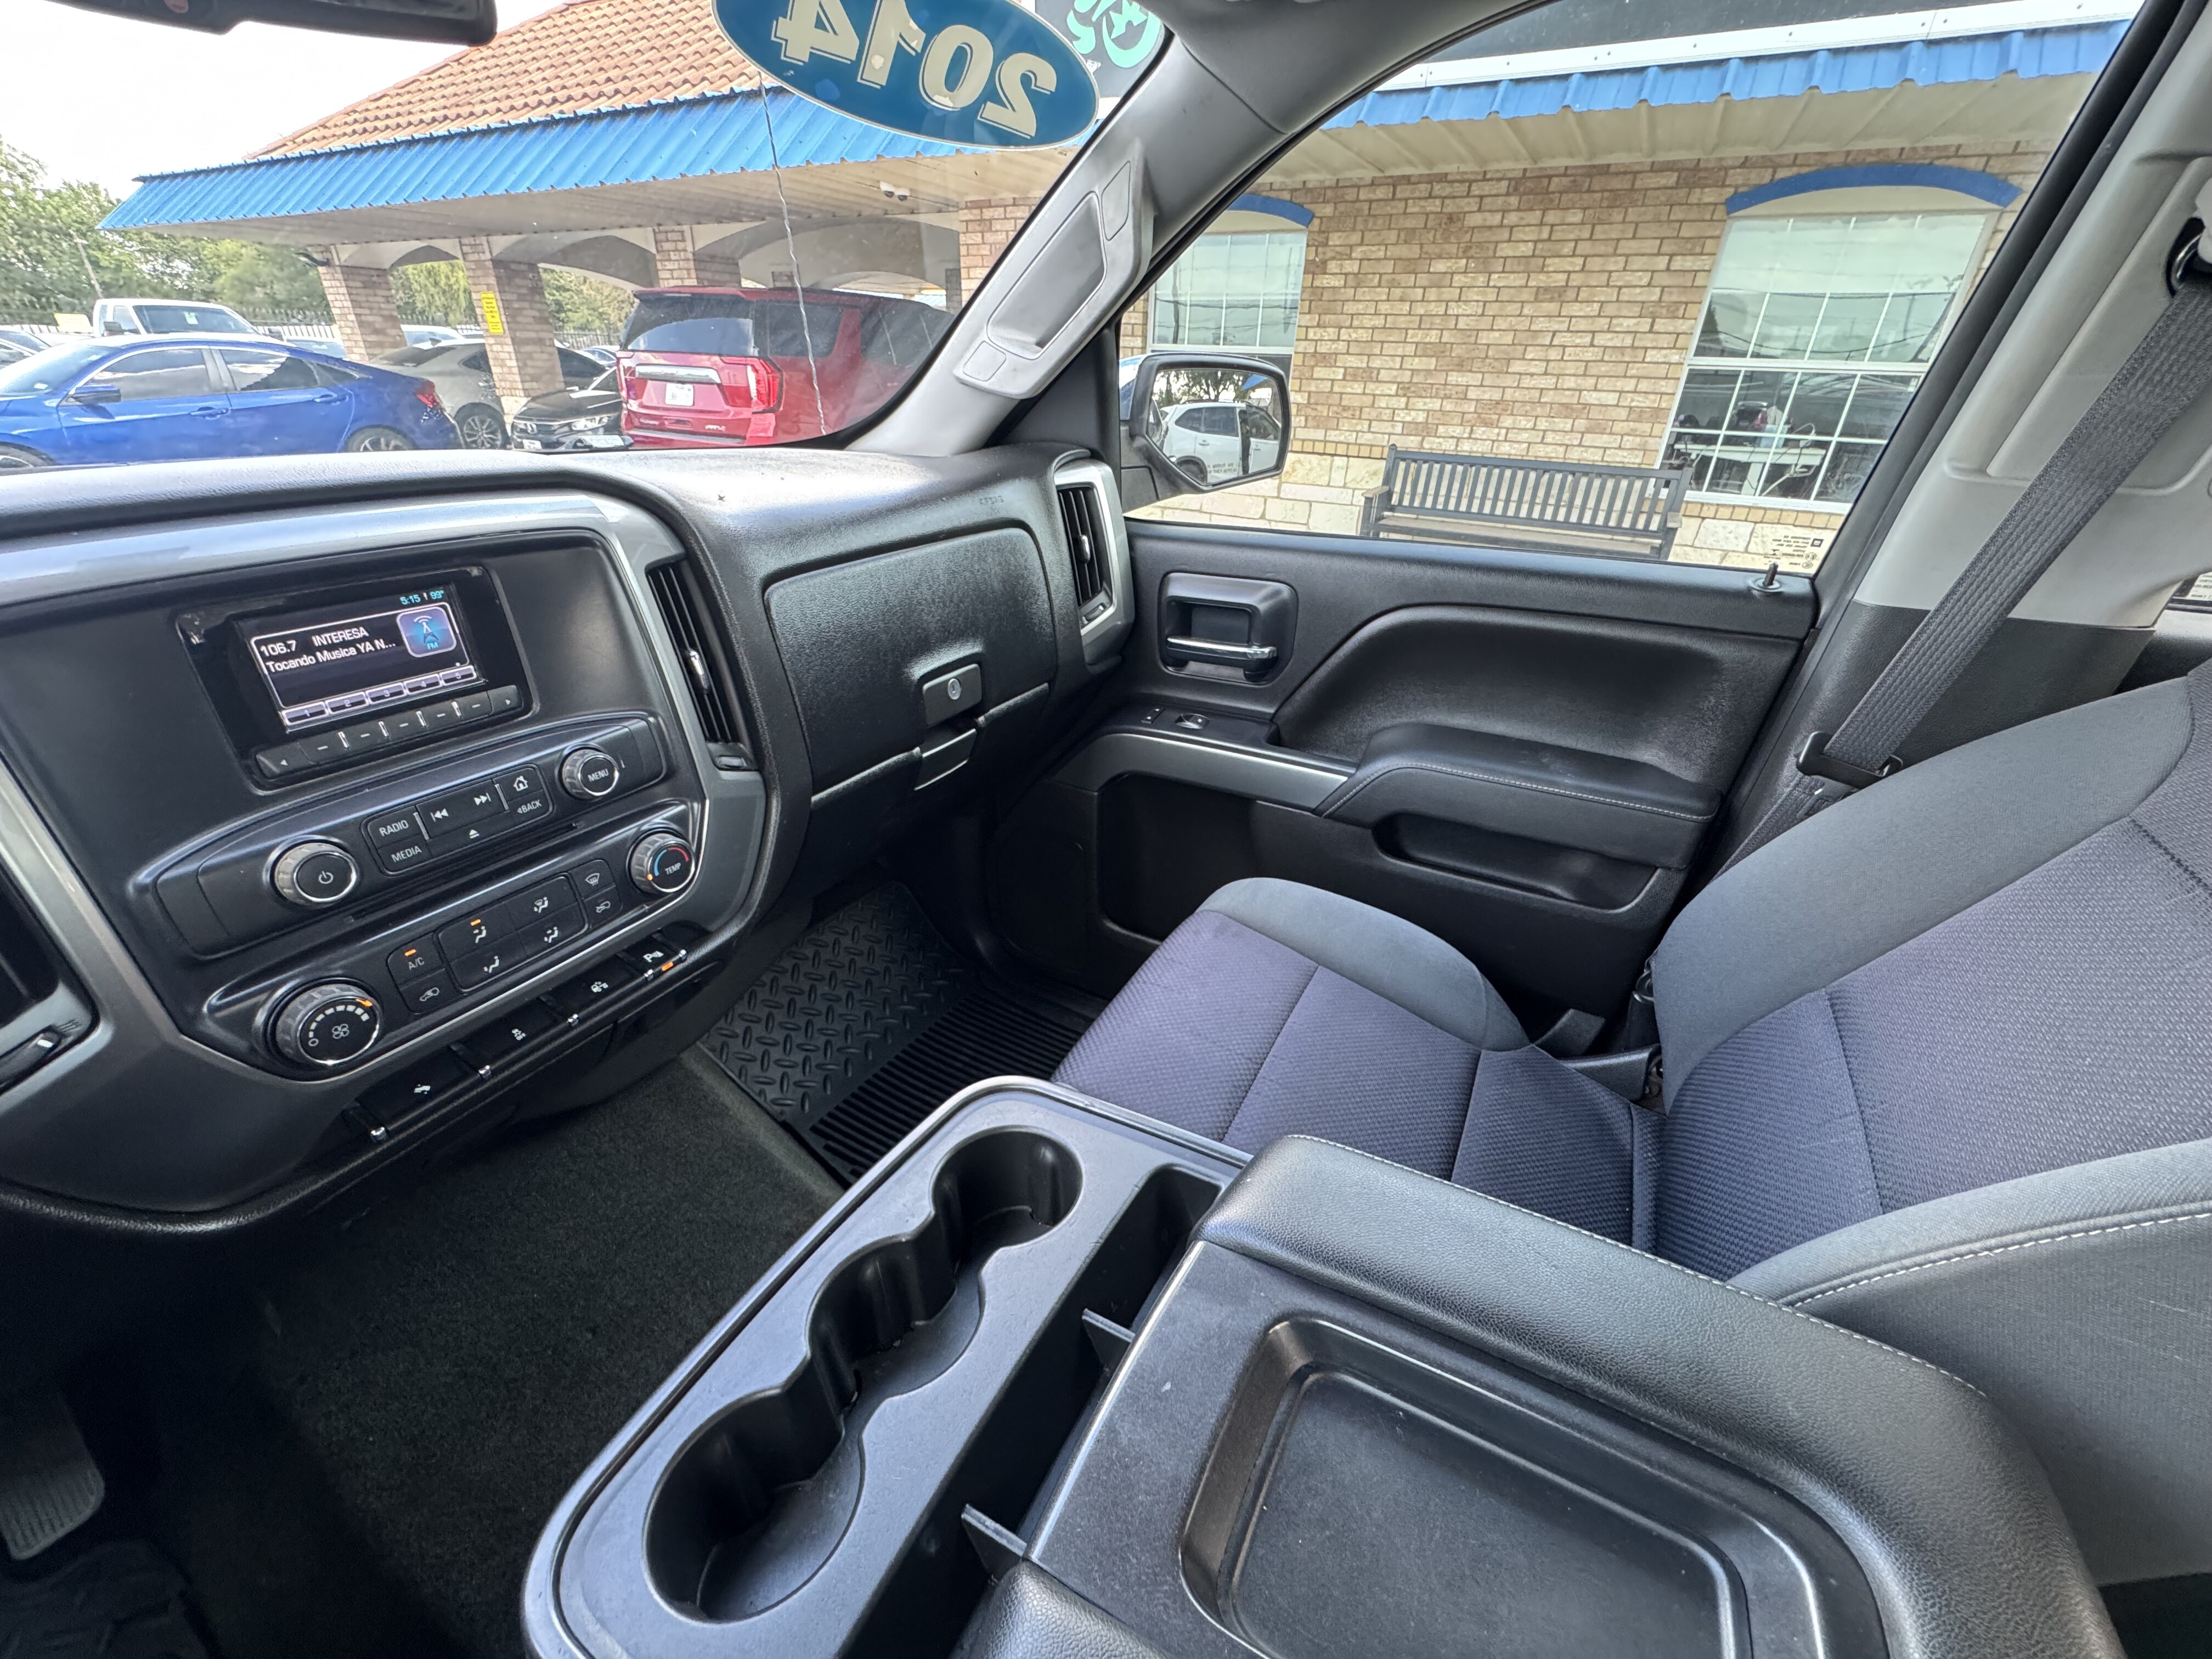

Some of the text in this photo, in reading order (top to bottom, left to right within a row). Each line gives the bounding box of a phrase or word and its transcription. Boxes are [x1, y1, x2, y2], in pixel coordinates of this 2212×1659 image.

[399, 594, 421, 605] 5:15
[259, 627, 370, 657] 106.7 INTERESA
[426, 642, 439, 650] FM
[266, 653, 316, 673] Tocando
[317, 646, 357, 663] Musica
[356, 642, 375, 653] YA
[588, 768, 609, 782] MENU
[522, 799, 542, 814] BACK
[379, 820, 409, 837] RADIO
[391, 845, 422, 862] MEDIA
[665, 862, 681, 875] TEMP
[408, 957, 425, 970] A/C
